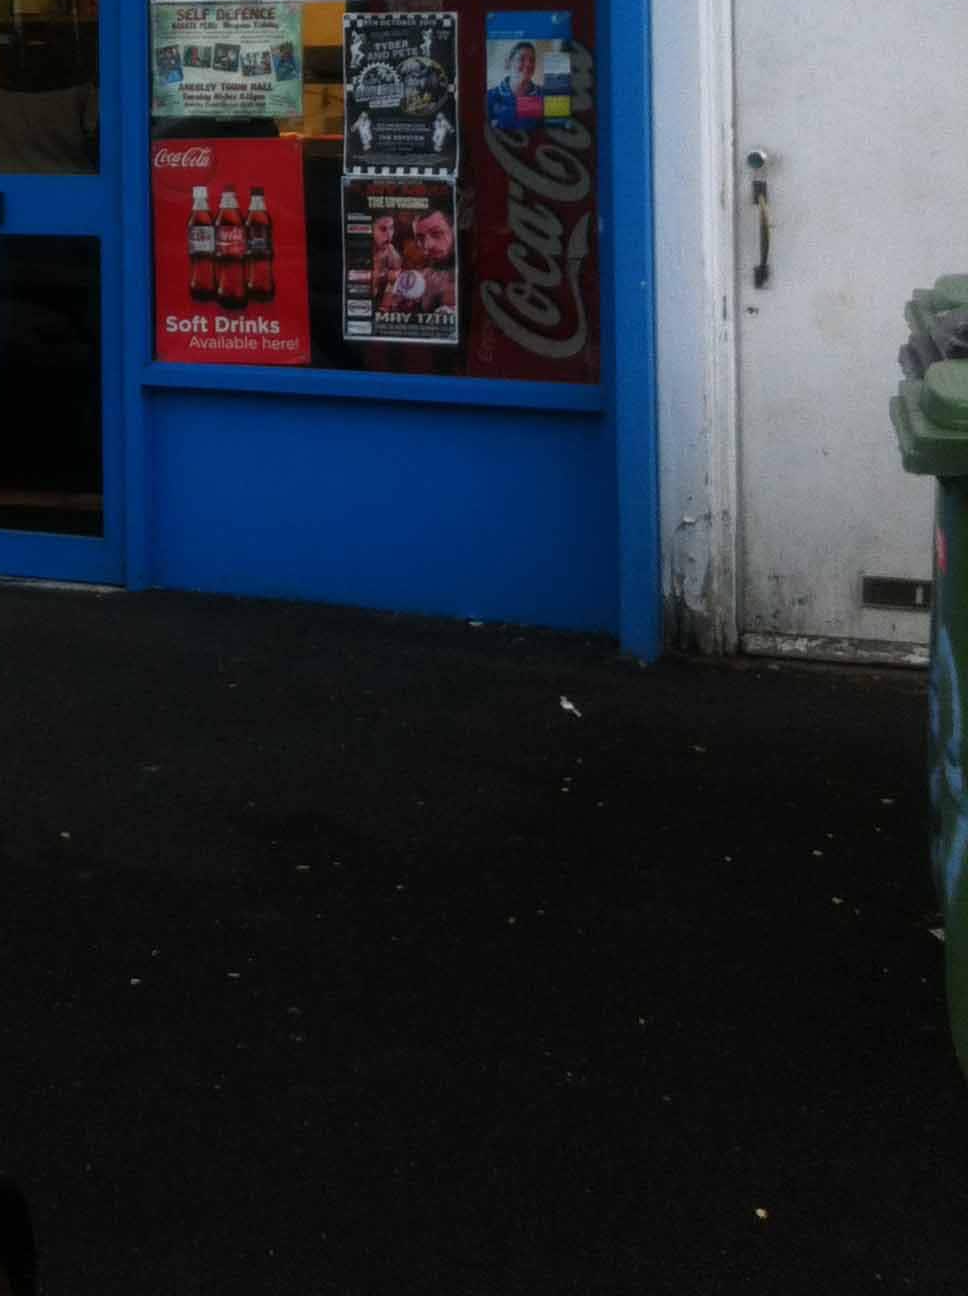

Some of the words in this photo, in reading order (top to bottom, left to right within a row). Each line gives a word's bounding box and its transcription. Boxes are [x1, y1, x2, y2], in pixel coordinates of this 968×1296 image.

[177, 7, 209, 21] SELF
[216, 7, 276, 21] DEFENCE
[375, 312, 411, 323] MAY
[165, 315, 208, 333] Soft
[215, 316, 281, 335] Drinks
[189, 335, 257, 350] Available
